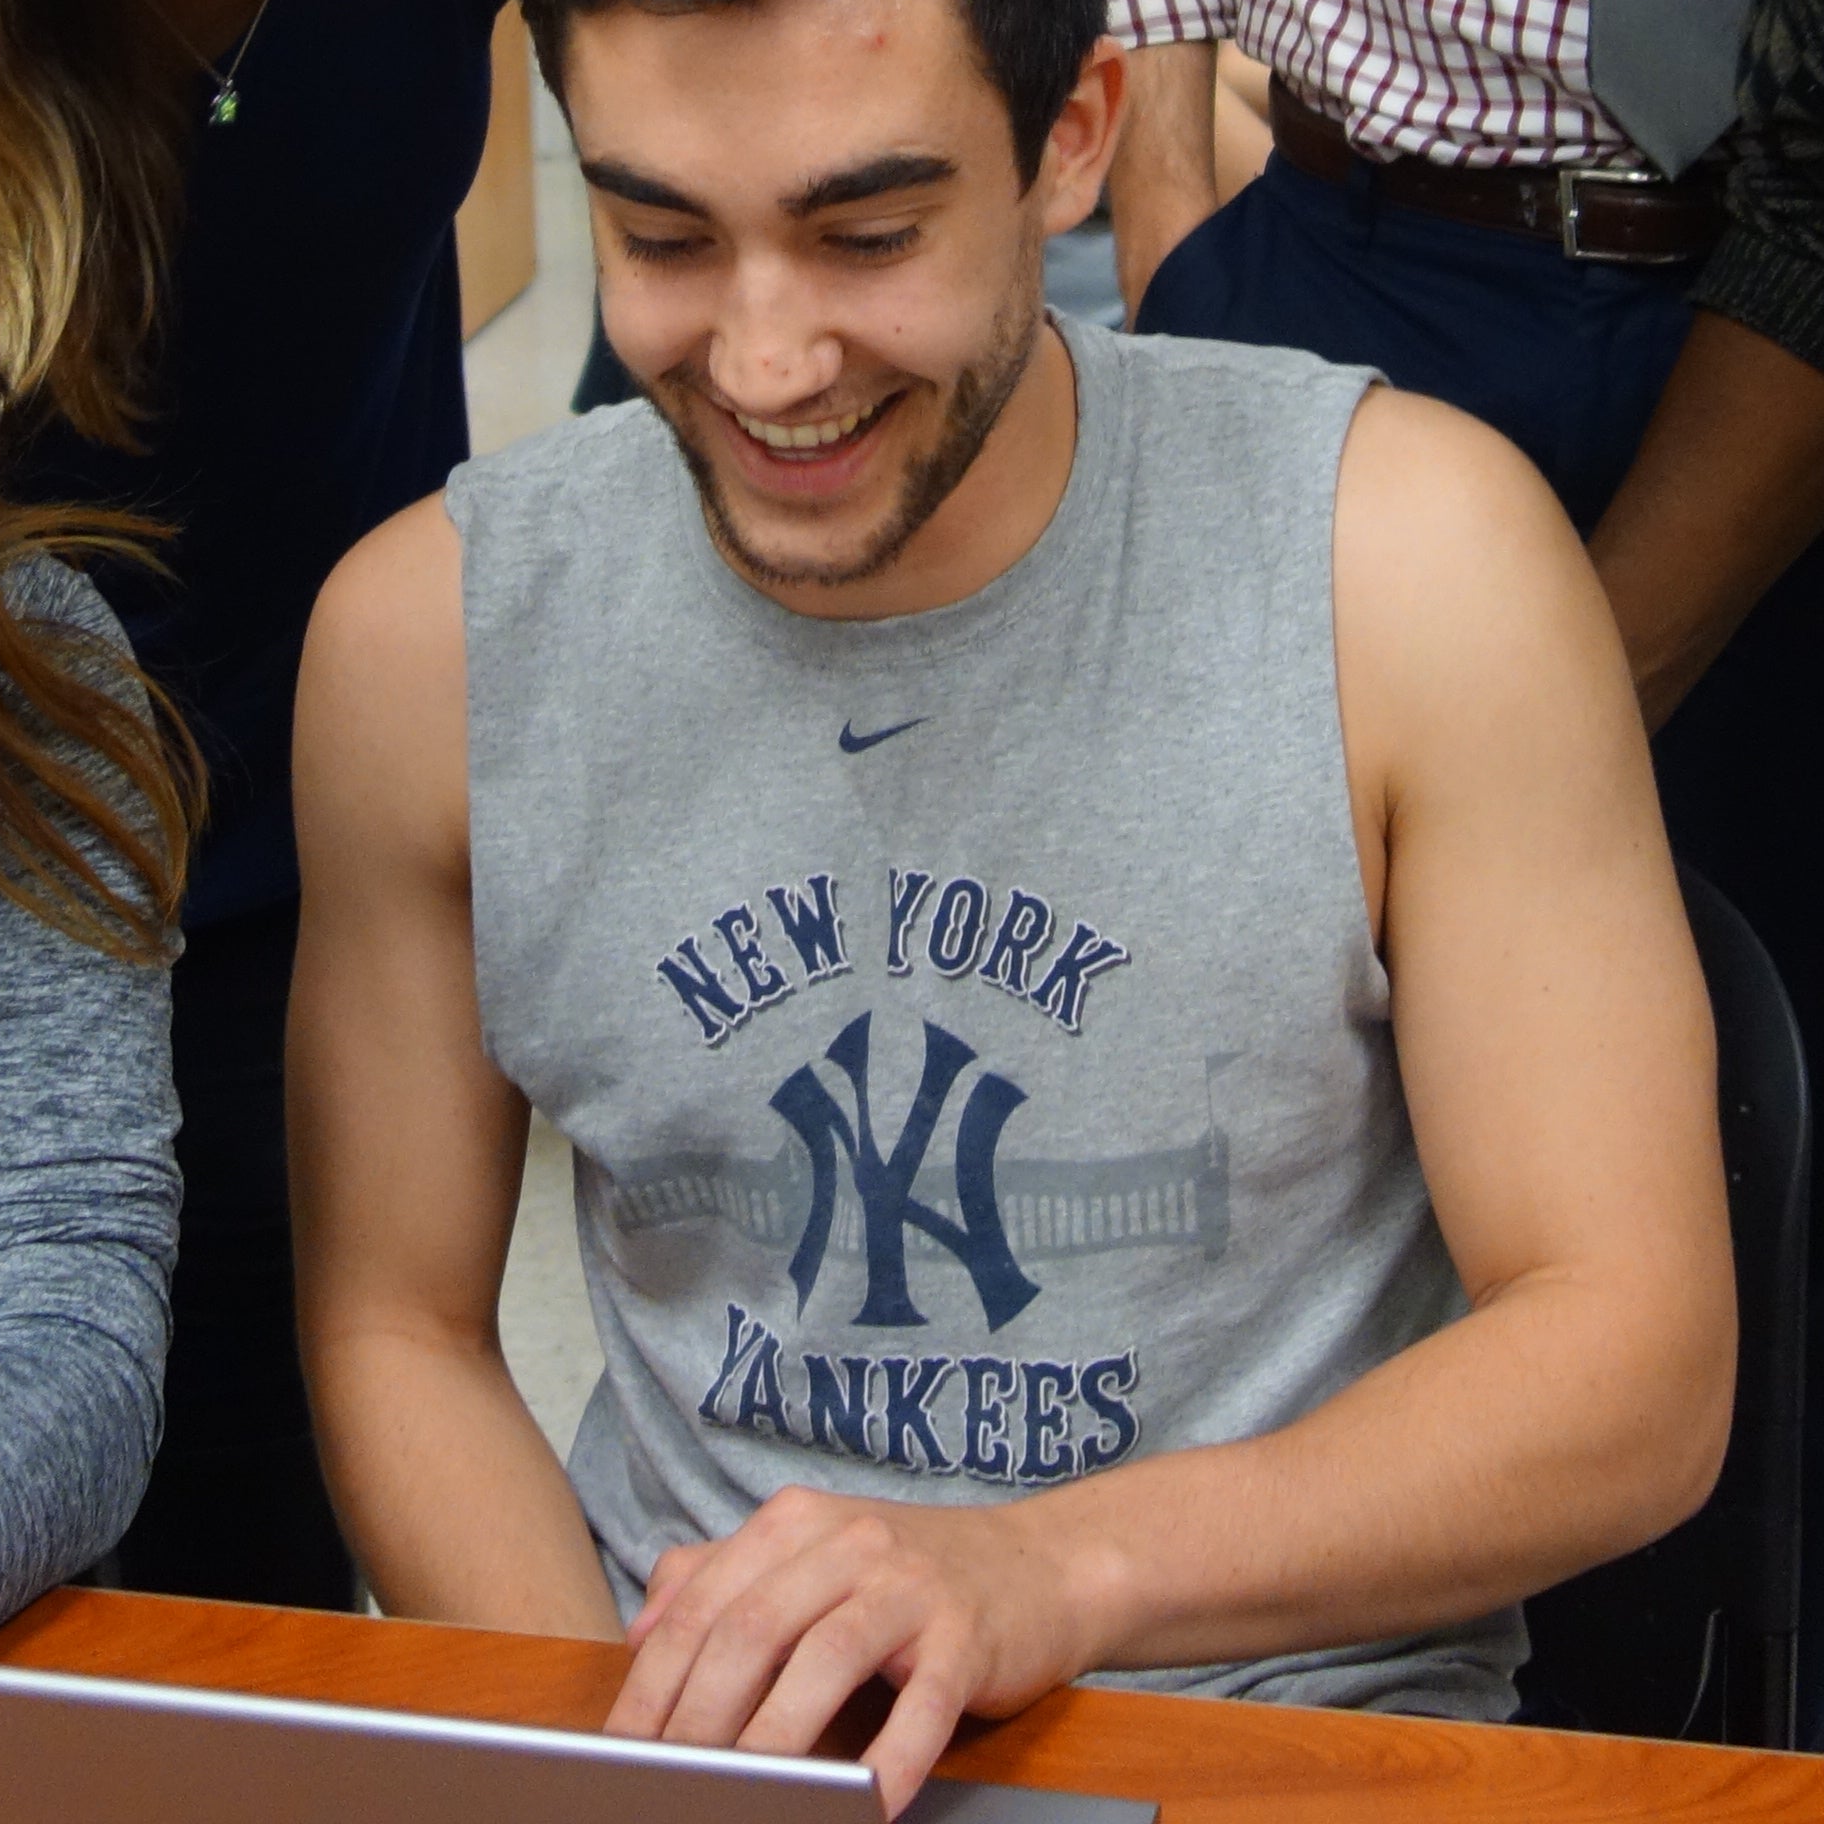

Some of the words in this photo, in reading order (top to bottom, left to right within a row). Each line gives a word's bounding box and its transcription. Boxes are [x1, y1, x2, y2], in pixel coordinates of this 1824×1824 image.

[655, 871, 850, 1046] NEW
[886, 866, 1132, 1036] YORK
[767, 1008, 1043, 1334] NY
[697, 1302, 1140, 1487] YANKEES
